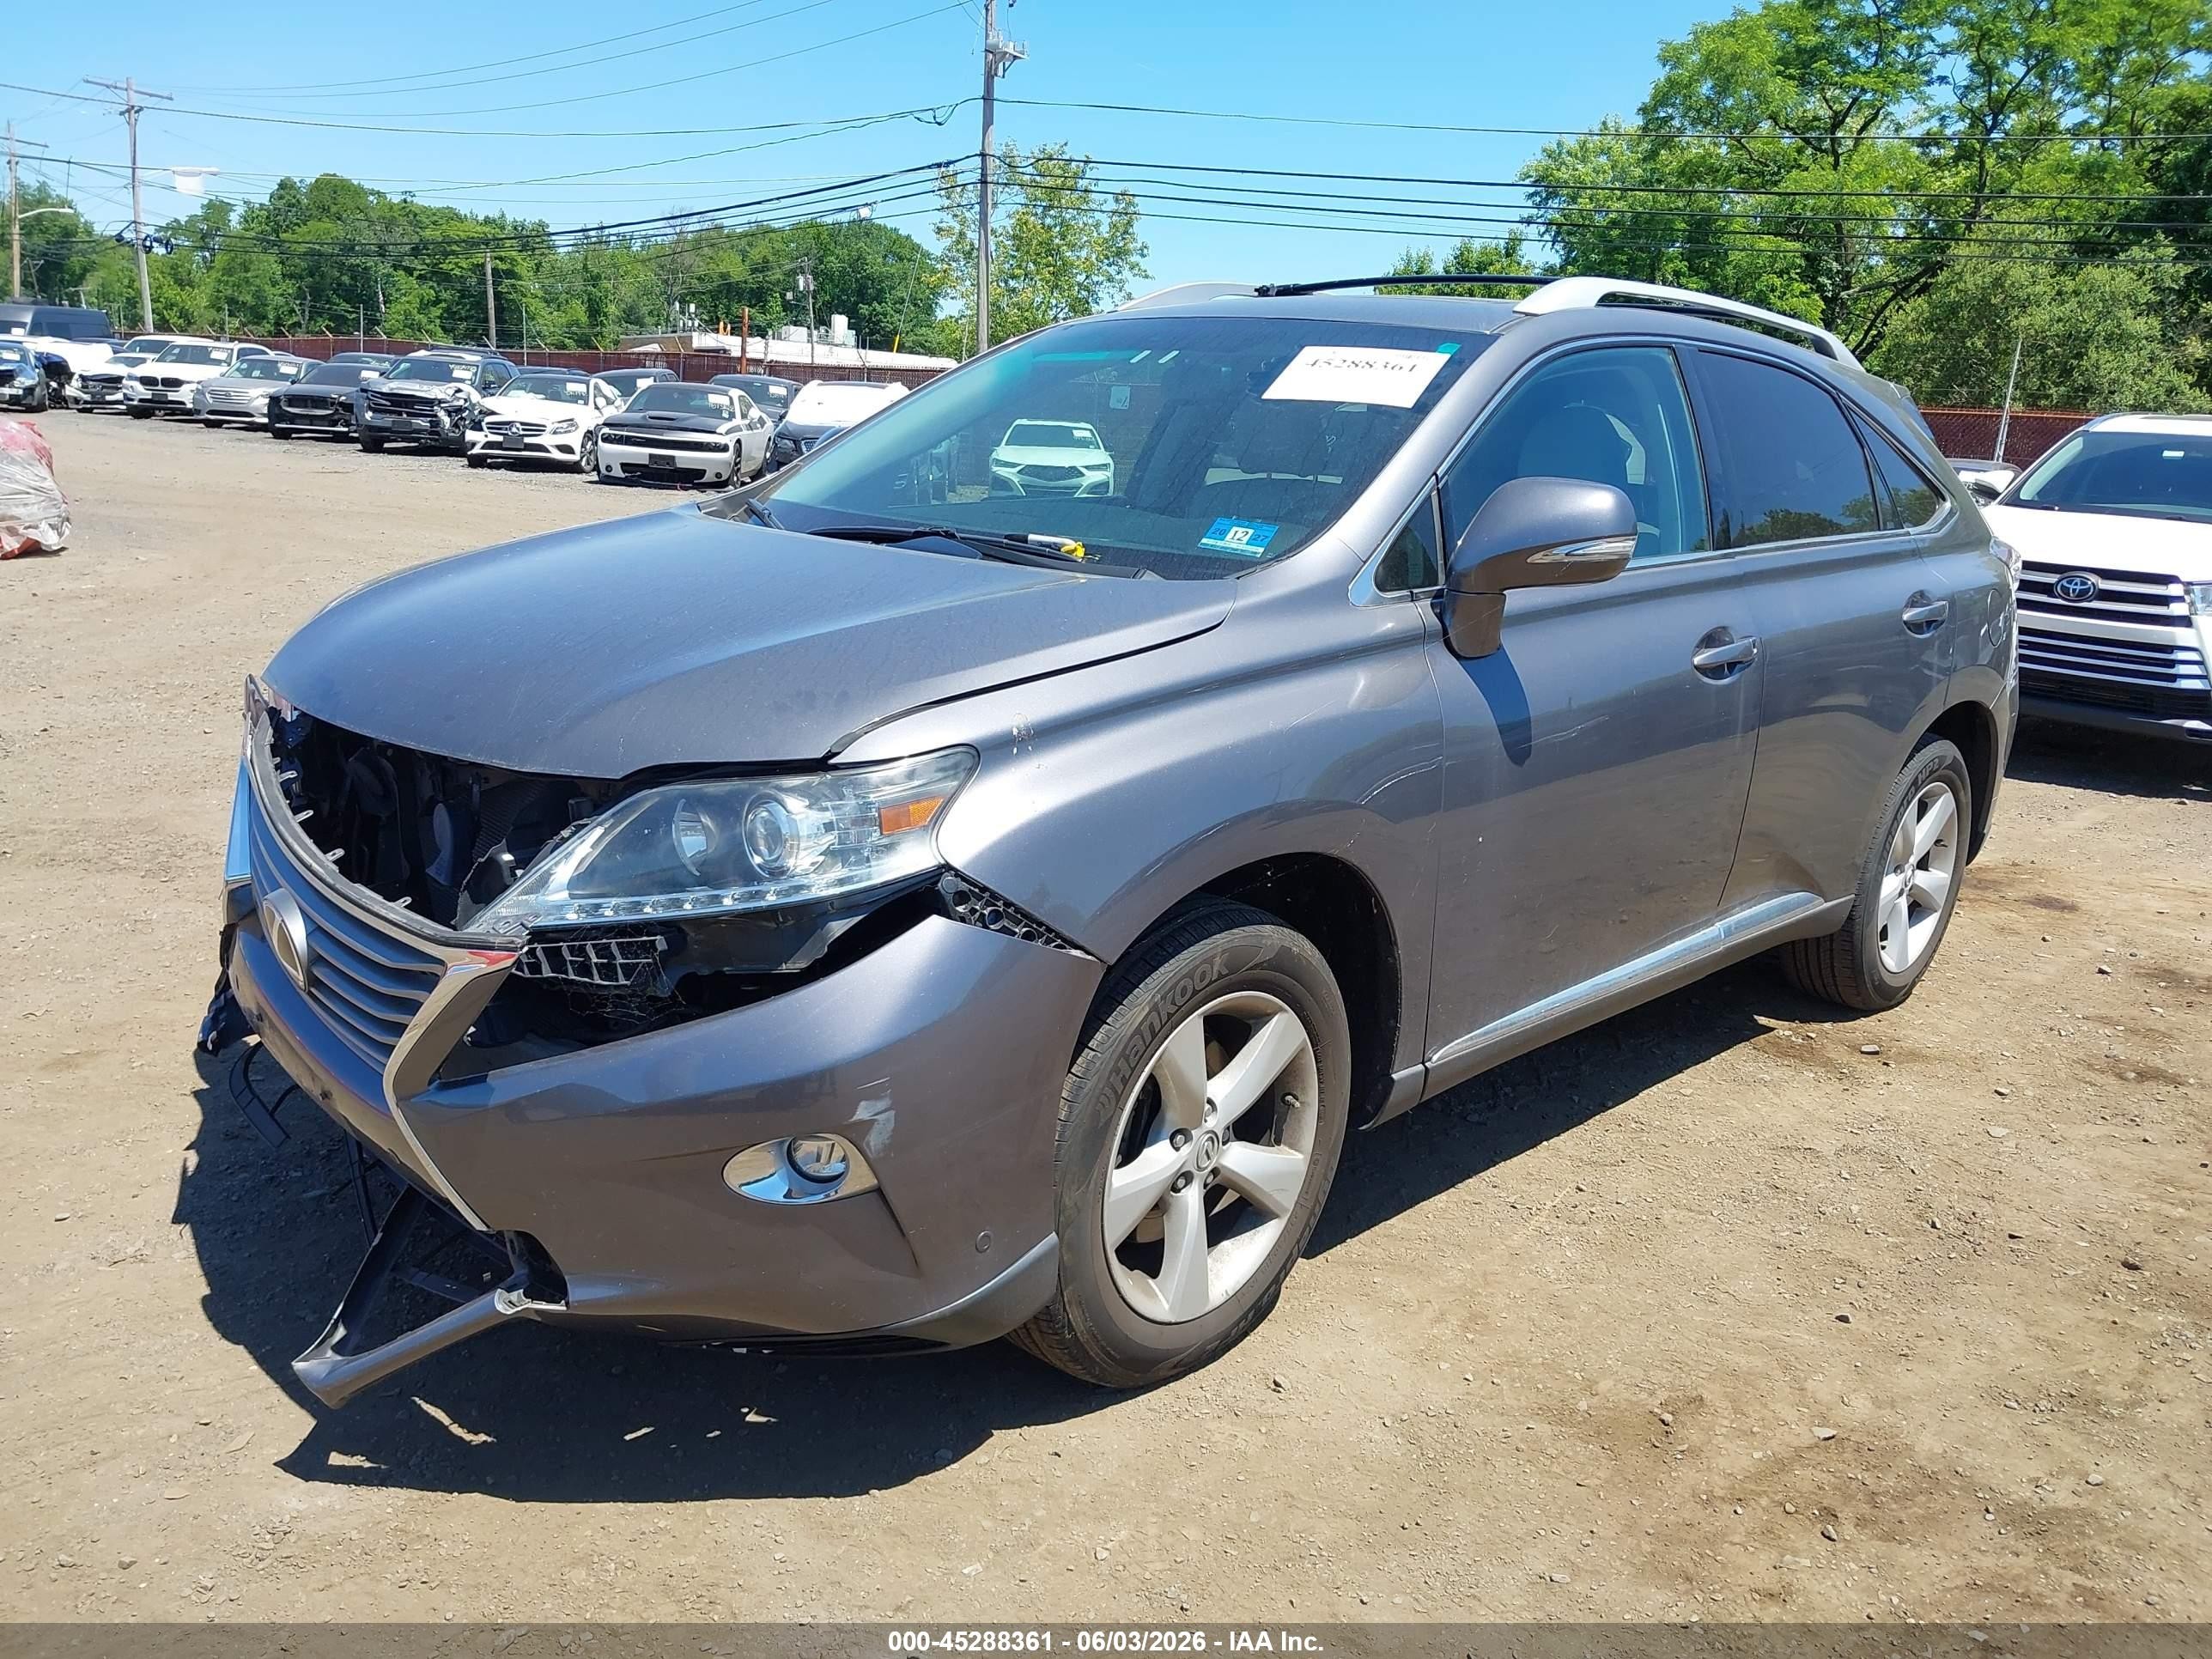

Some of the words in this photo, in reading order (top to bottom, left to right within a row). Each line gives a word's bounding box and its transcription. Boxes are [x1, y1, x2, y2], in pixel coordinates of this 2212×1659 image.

[1211, 527, 1227, 537] 20
[1229, 529, 1249, 542] 12
[1108, 951, 1230, 1097] Hankook
